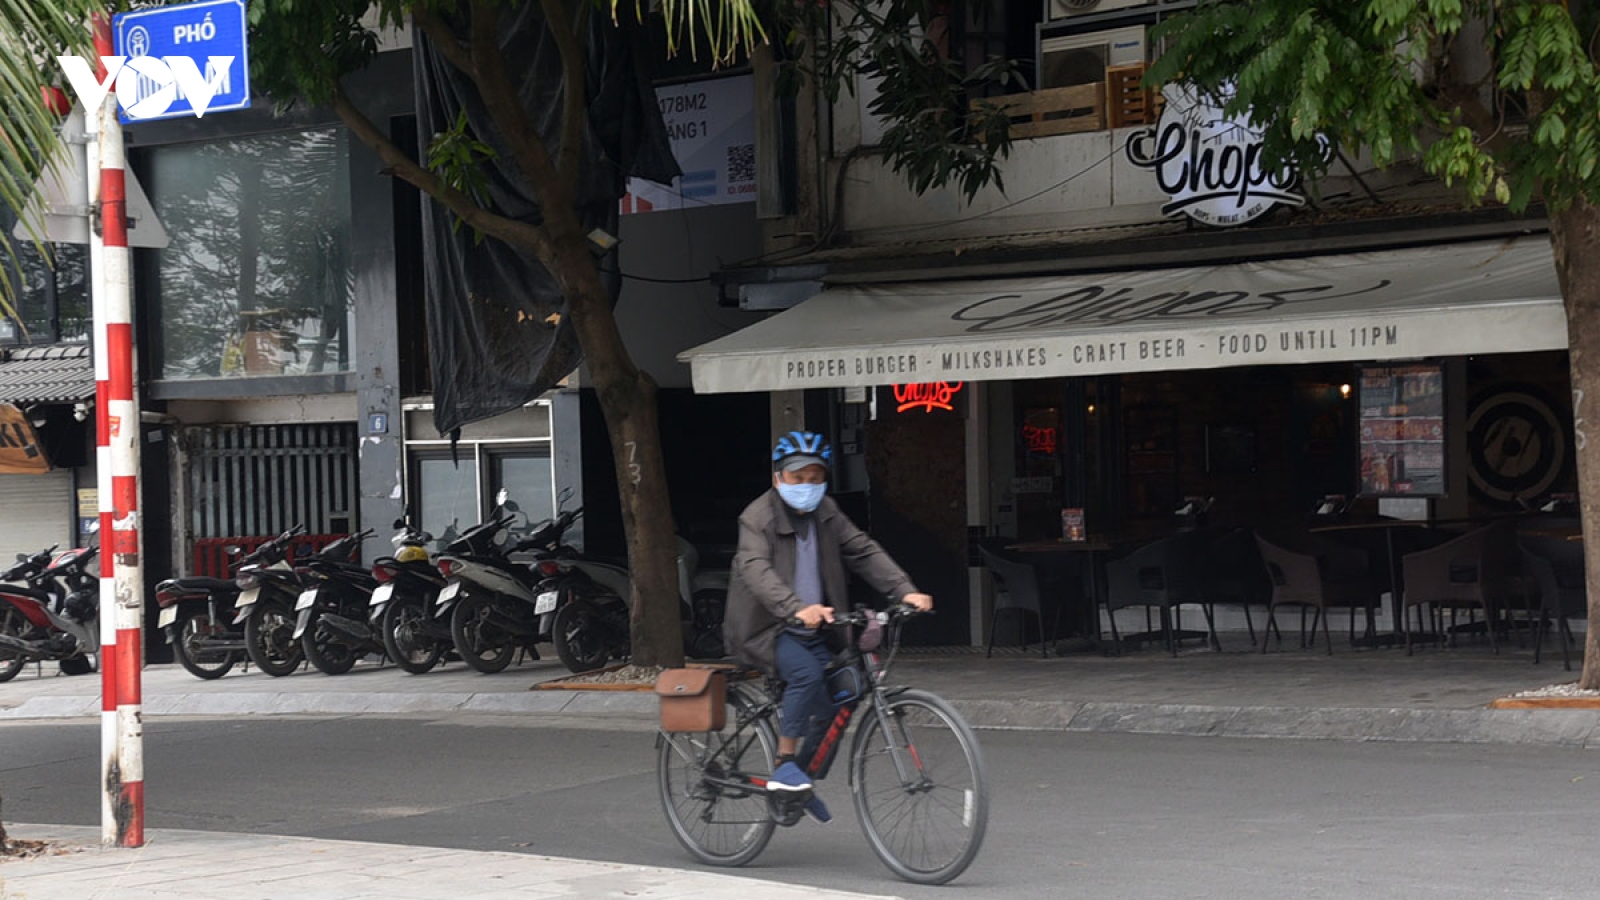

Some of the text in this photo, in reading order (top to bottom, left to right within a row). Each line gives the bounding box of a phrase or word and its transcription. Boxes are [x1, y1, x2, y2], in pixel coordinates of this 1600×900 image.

[173, 11, 216, 45] PHỐ
[787, 358, 847, 379] PROPER
[855, 354, 917, 375] BURGER
[942, 347, 1047, 370] MILKSHAKES
[1073, 342, 1127, 364] CRAFT
[1139, 338, 1185, 359] BEER
[1219, 333, 1268, 355] FOOD
[1280, 328, 1336, 351] UNTIL
[1350, 325, 1397, 347] 11PM
[374, 416, 382, 430] 6
